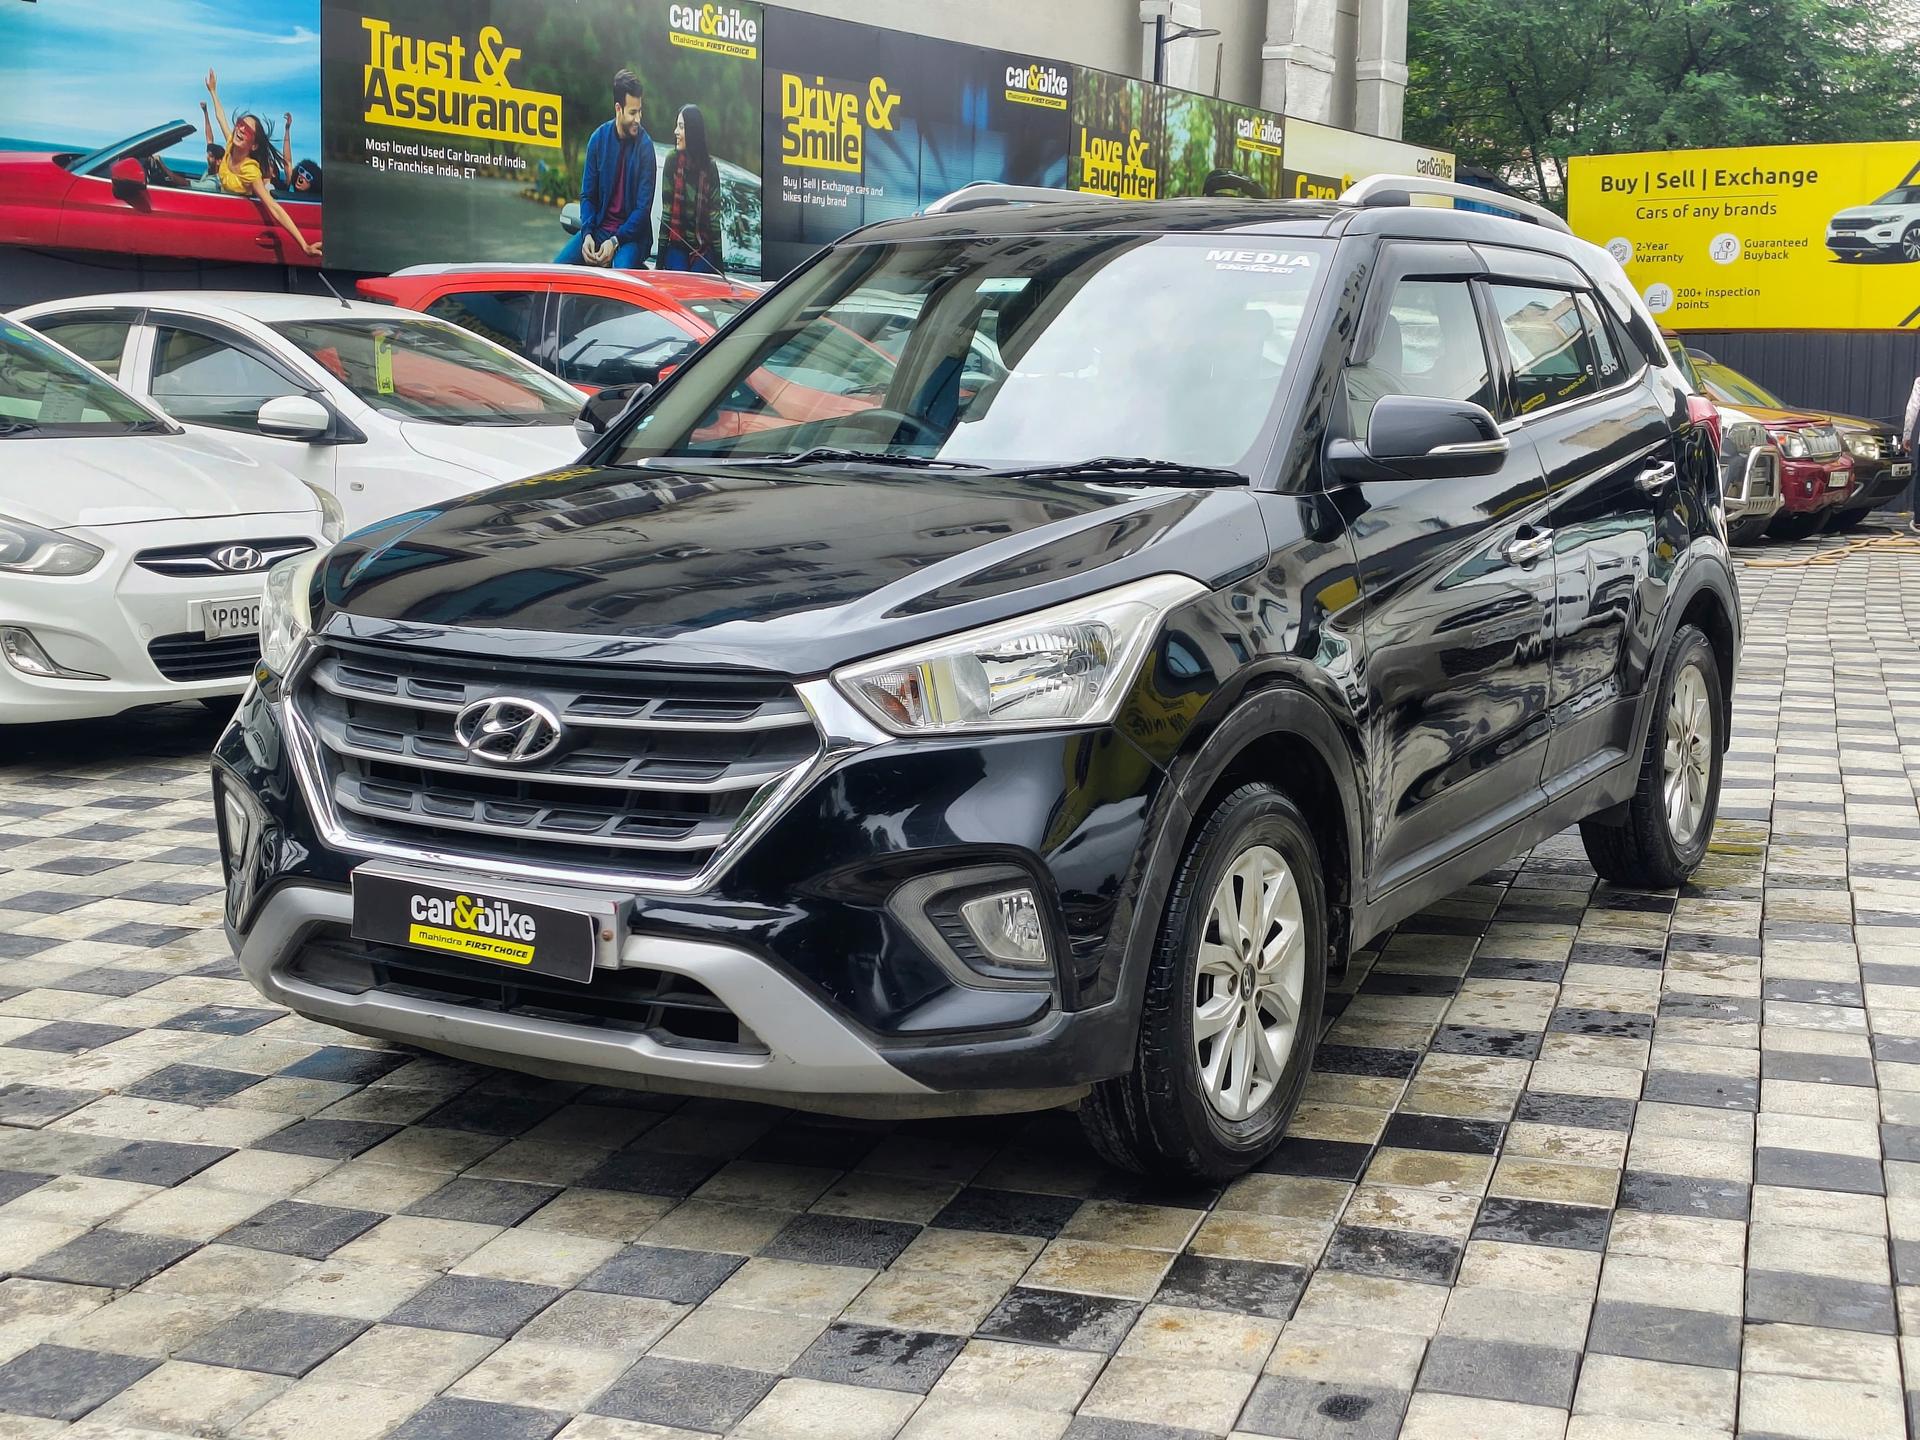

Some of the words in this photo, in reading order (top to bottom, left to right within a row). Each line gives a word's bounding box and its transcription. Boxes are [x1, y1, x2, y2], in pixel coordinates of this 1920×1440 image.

[669, 4, 757, 43] car&bike
[362, 17, 466, 82] Trust
[474, 25, 522, 88] &
[1005, 64, 1068, 96] car&bike
[365, 68, 559, 139] Assurance
[782, 73, 859, 125] Drive
[865, 76, 901, 131] &
[781, 116, 860, 165] Smile
[1236, 116, 1282, 145] car&bike
[365, 138, 391, 152] Most
[393, 140, 419, 156] loved
[421, 145, 445, 160] Used
[447, 149, 462, 162] Car
[465, 150, 491, 165] brand
[493, 155, 503, 167] of
[504, 157, 527, 169] India
[1081, 127, 1123, 163] Love
[1126, 128, 1150, 169] &
[372, 157, 386, 171] By
[388, 158, 434, 175] Franchise
[436, 165, 462, 180] India,
[464, 168, 476, 180] ET
[1080, 158, 1156, 199] Laughter
[1601, 175, 1638, 194] Buy
[1656, 169, 1695, 189] Sell
[1714, 167, 1818, 188] Exchange
[782, 190, 802, 203] bikes
[803, 192, 811, 204] of
[811, 196, 826, 207] any
[826, 195, 847, 207] brand
[783, 175, 798, 189] Buy
[803, 178, 817, 189] Sell
[821, 180, 854, 195] Exchange
[855, 186, 869, 195] cars
[870, 186, 884, 197] and
[1636, 206, 1668, 220] Cars
[1673, 204, 1689, 218] of
[1692, 205, 1719, 220] any
[1724, 202, 1777, 217] brands
[1636, 242, 1669, 252] 2-Year
[1743, 249, 1790, 262] Buyback
[1744, 237, 1808, 249] Guaranteed
[1205, 249, 1312, 267] MEDIA
[1635, 253, 1684, 263] Warranty
[1676, 287, 1703, 298] 200+
[1705, 287, 1761, 299] inspection
[1676, 301, 1709, 311] points
[410, 894, 536, 942] car&bike
[465, 940, 492, 952] FIRST
[494, 946, 528, 959] CHOICE
